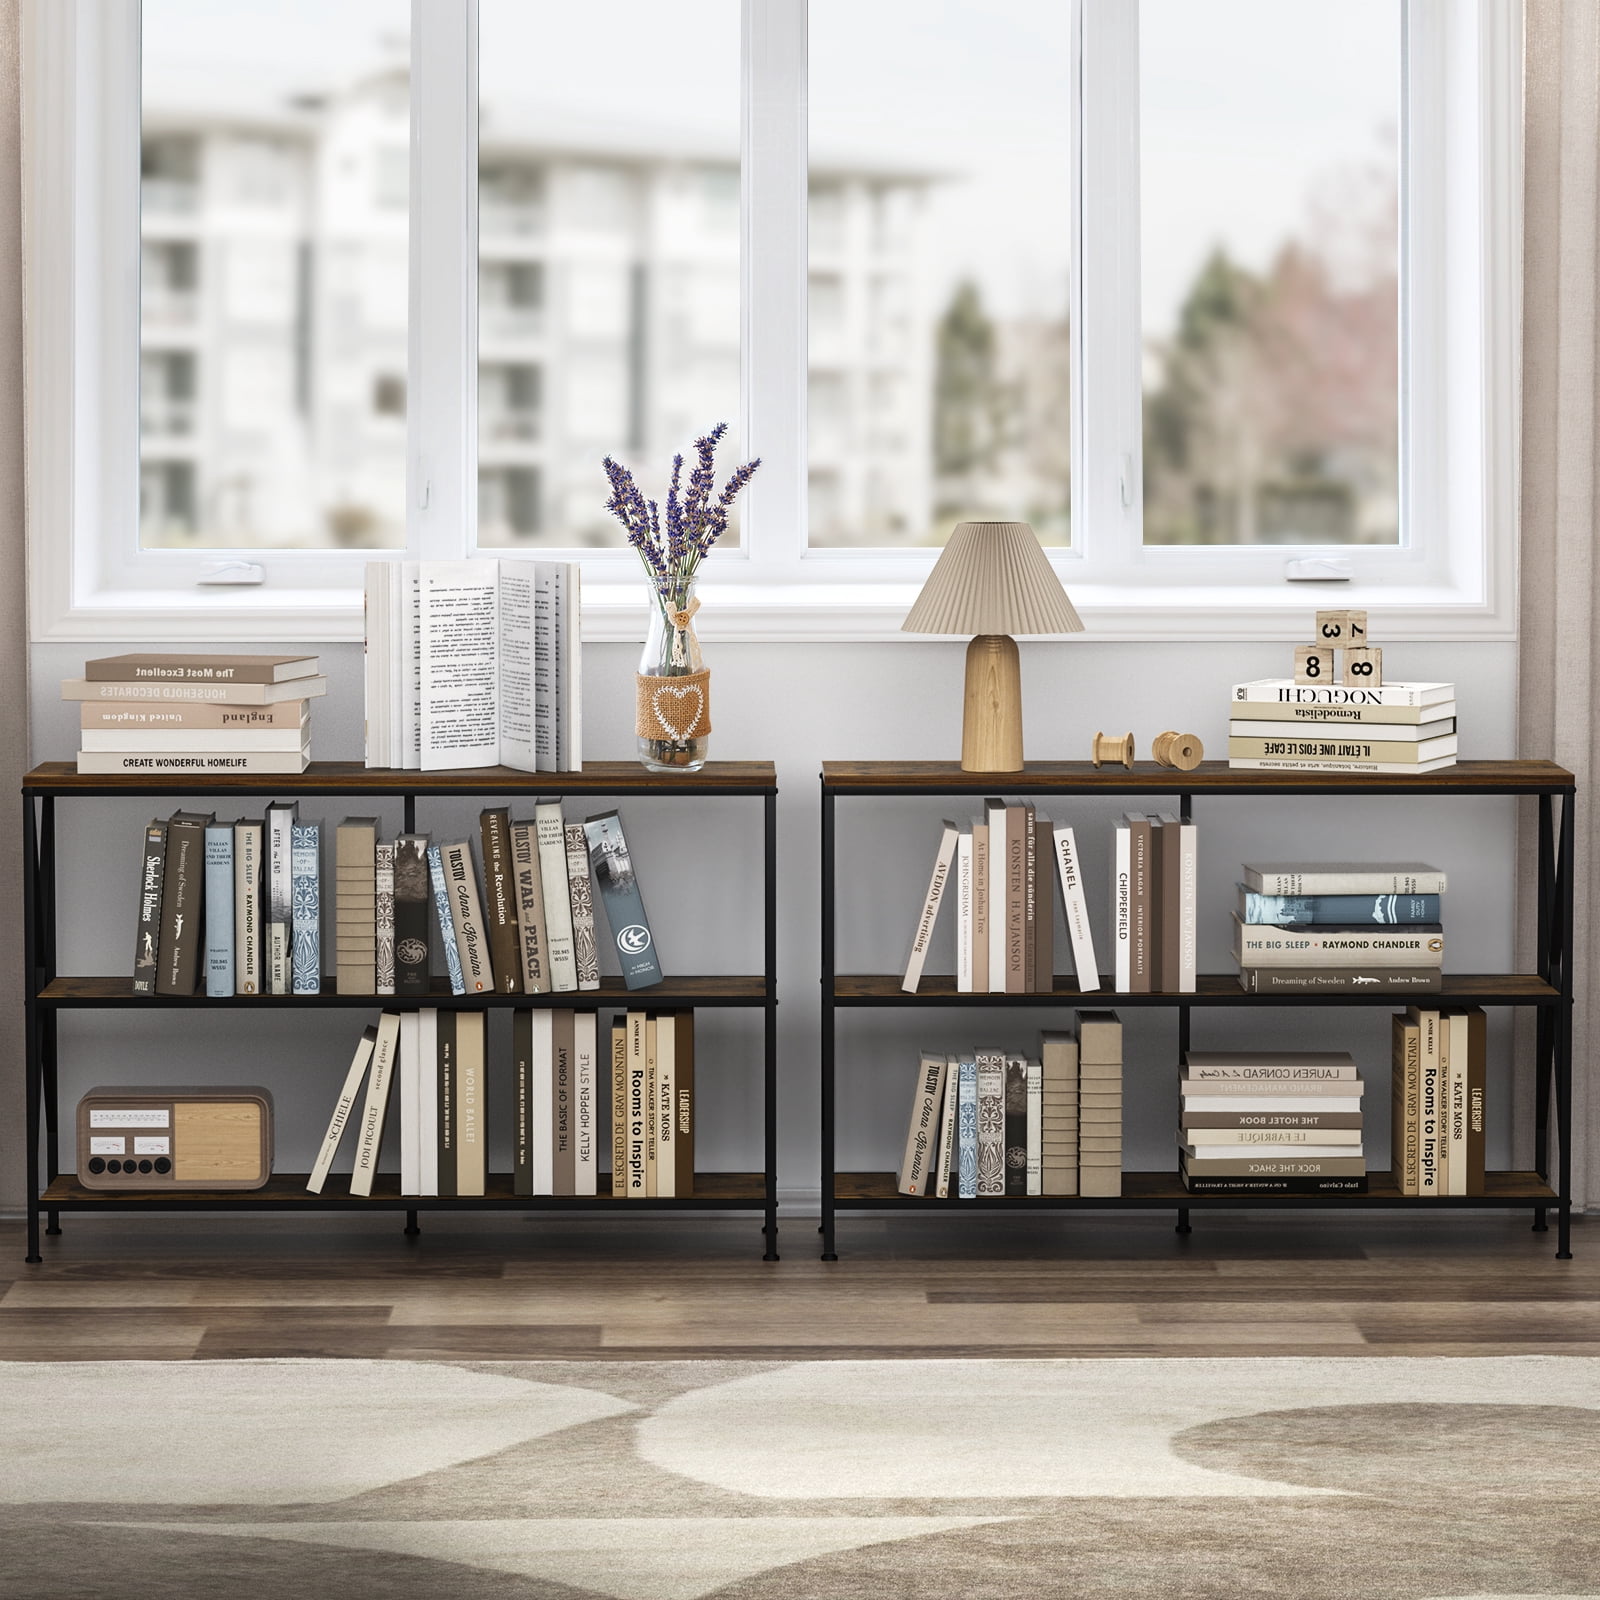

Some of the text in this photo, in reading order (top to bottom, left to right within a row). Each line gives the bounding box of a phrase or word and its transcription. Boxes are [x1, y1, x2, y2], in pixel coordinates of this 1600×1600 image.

[1322, 624, 1341, 638] 3
[1352, 623, 1364, 638] 7
[1306, 656, 1320, 678] 8
[1351, 661, 1373, 676] 8
[102, 713, 182, 722] United Kingdom
[222, 712, 273, 724] England
[1278, 688, 1382, 704] NOGUCHI
[1295, 709, 1361, 720] Remodelista
[123, 758, 247, 767] CREATE WONDERFUL HOMELIFE
[1264, 742, 1370, 759] IL ÉTAIT UNE FOIS LE CAFÉ
[489, 814, 500, 859] REVEALING
[514, 827, 531, 864] TOLSTOY
[176, 840, 190, 908] Dreaming of Sweden
[449, 849, 466, 881] TOLSTOY
[978, 878, 986, 886] in
[1060, 839, 1076, 890] CHANEL
[143, 856, 161, 922] Sherlock Holmes
[457, 886, 469, 919] Anna
[494, 874, 506, 925] Revolution
[520, 871, 534, 910] WAR
[914, 862, 947, 953] AVEDON advertising
[976, 887, 986, 915] Joshua
[1010, 839, 1021, 972] KONSTEN H.W.JANSON
[1119, 873, 1128, 940] CHIPPERFIELD
[524, 925, 541, 979] PEACE
[1272, 976, 1307, 985] Dreaming
[1308, 976, 1317, 985] of
[1317, 976, 1345, 985] Sweden
[375, 1040, 389, 1090] second glance
[923, 1065, 940, 1096] TOLSTOY
[465, 1068, 475, 1143] WORLD BALLET
[560, 1088, 567, 1102] OF
[580, 1054, 590, 1162] KELLY HOPPEN STYLE
[615, 1038, 624, 1188] EL SECRETO DE GRAY MOUNTAIN
[679, 1089, 689, 1134] LEADERSHIP
[921, 1098, 933, 1128] Anna
[1407, 1037, 1416, 1186] EL SECRETO DE GRAY MOUNTAIN
[1454, 1082, 1462, 1140] KATE MOSS
[1472, 1088, 1482, 1132] LEADERSHIP
[329, 1095, 352, 1140] SCHIELE
[360, 1106, 379, 1169] JODI PICOULT
[629, 1070, 644, 1188] Rooms to Inspire
[1421, 1069, 1436, 1186] Rooms to Inspire
